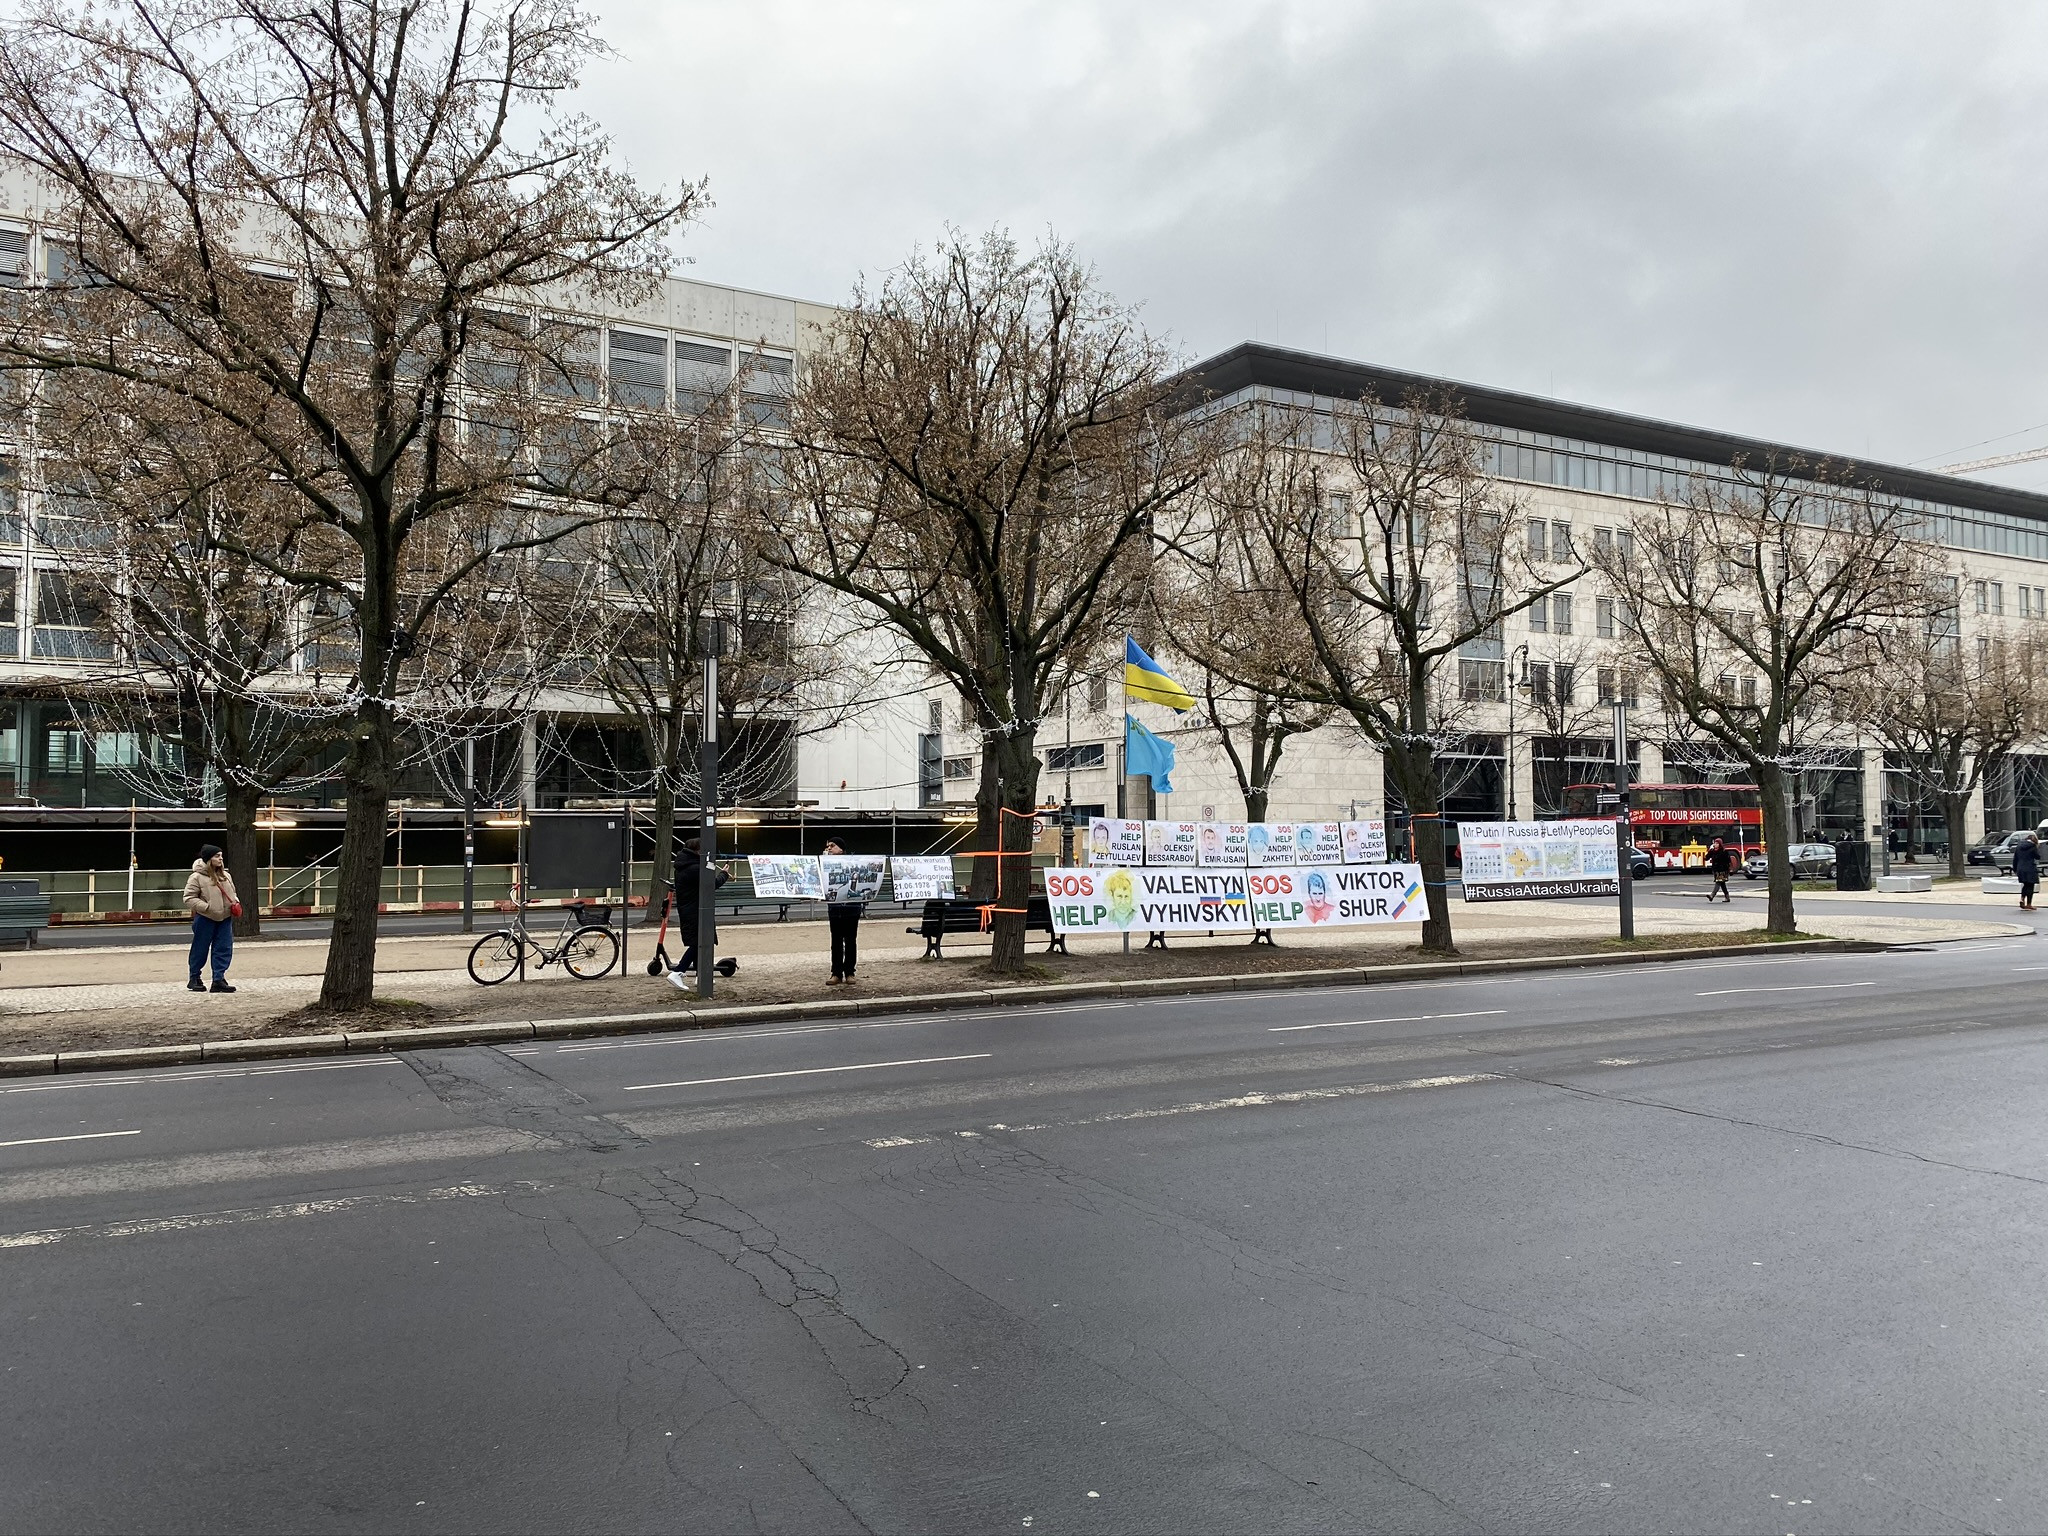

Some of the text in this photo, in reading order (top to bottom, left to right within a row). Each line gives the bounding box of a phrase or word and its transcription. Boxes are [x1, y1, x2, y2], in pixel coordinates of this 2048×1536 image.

[1650, 810, 1738, 820] TOP TOUR SIGHTSEEING
[1125, 823, 1141, 831] SOS
[1179, 824, 1194, 832] SOS
[1229, 825, 1245, 833] SOS
[1277, 825, 1292, 833] SOS
[1324, 824, 1338, 832] SOS
[1369, 822, 1383, 830] SOS
[1367, 832, 1384, 840] HELP
[1508, 826, 1539, 837] Russia
[1541, 825, 1615, 839] #LetMyPeopleGo
[1120, 832, 1141, 841] HELP
[1176, 834, 1194, 842] HELP
[1226, 835, 1245, 843] HELP
[1275, 835, 1292, 843] HELP
[1321, 834, 1339, 842] HELP
[1111, 842, 1141, 851] RUSLAN
[1163, 844, 1195, 852] OLEKSIY
[1224, 845, 1245, 853] KUKU
[1316, 844, 1339, 852] DUDKA
[1360, 841, 1385, 849] OLEKSIY
[1096, 852, 1141, 862] ZEYTULLAEV
[1148, 854, 1195, 862] BESSARABOV
[1205, 855, 1245, 863] EMIR-USAIN
[1262, 854, 1293, 862] ZAKHTEY
[1142, 875, 1245, 894] VALENTYN
[1336, 871, 1405, 890] VIKTOR
[894, 882, 931, 891] 21.06.1978
[1049, 876, 1094, 896] SOS
[1250, 875, 1293, 895] SOS
[1467, 882, 1618, 898] #RussiaAttacksUkraine
[895, 891, 932, 900] 21.07.2019
[1339, 898, 1388, 917] SHUR
[1052, 904, 1107, 926] HELP
[1140, 903, 1248, 923] VYHIVSKYI
[1254, 902, 1304, 922] HELP
